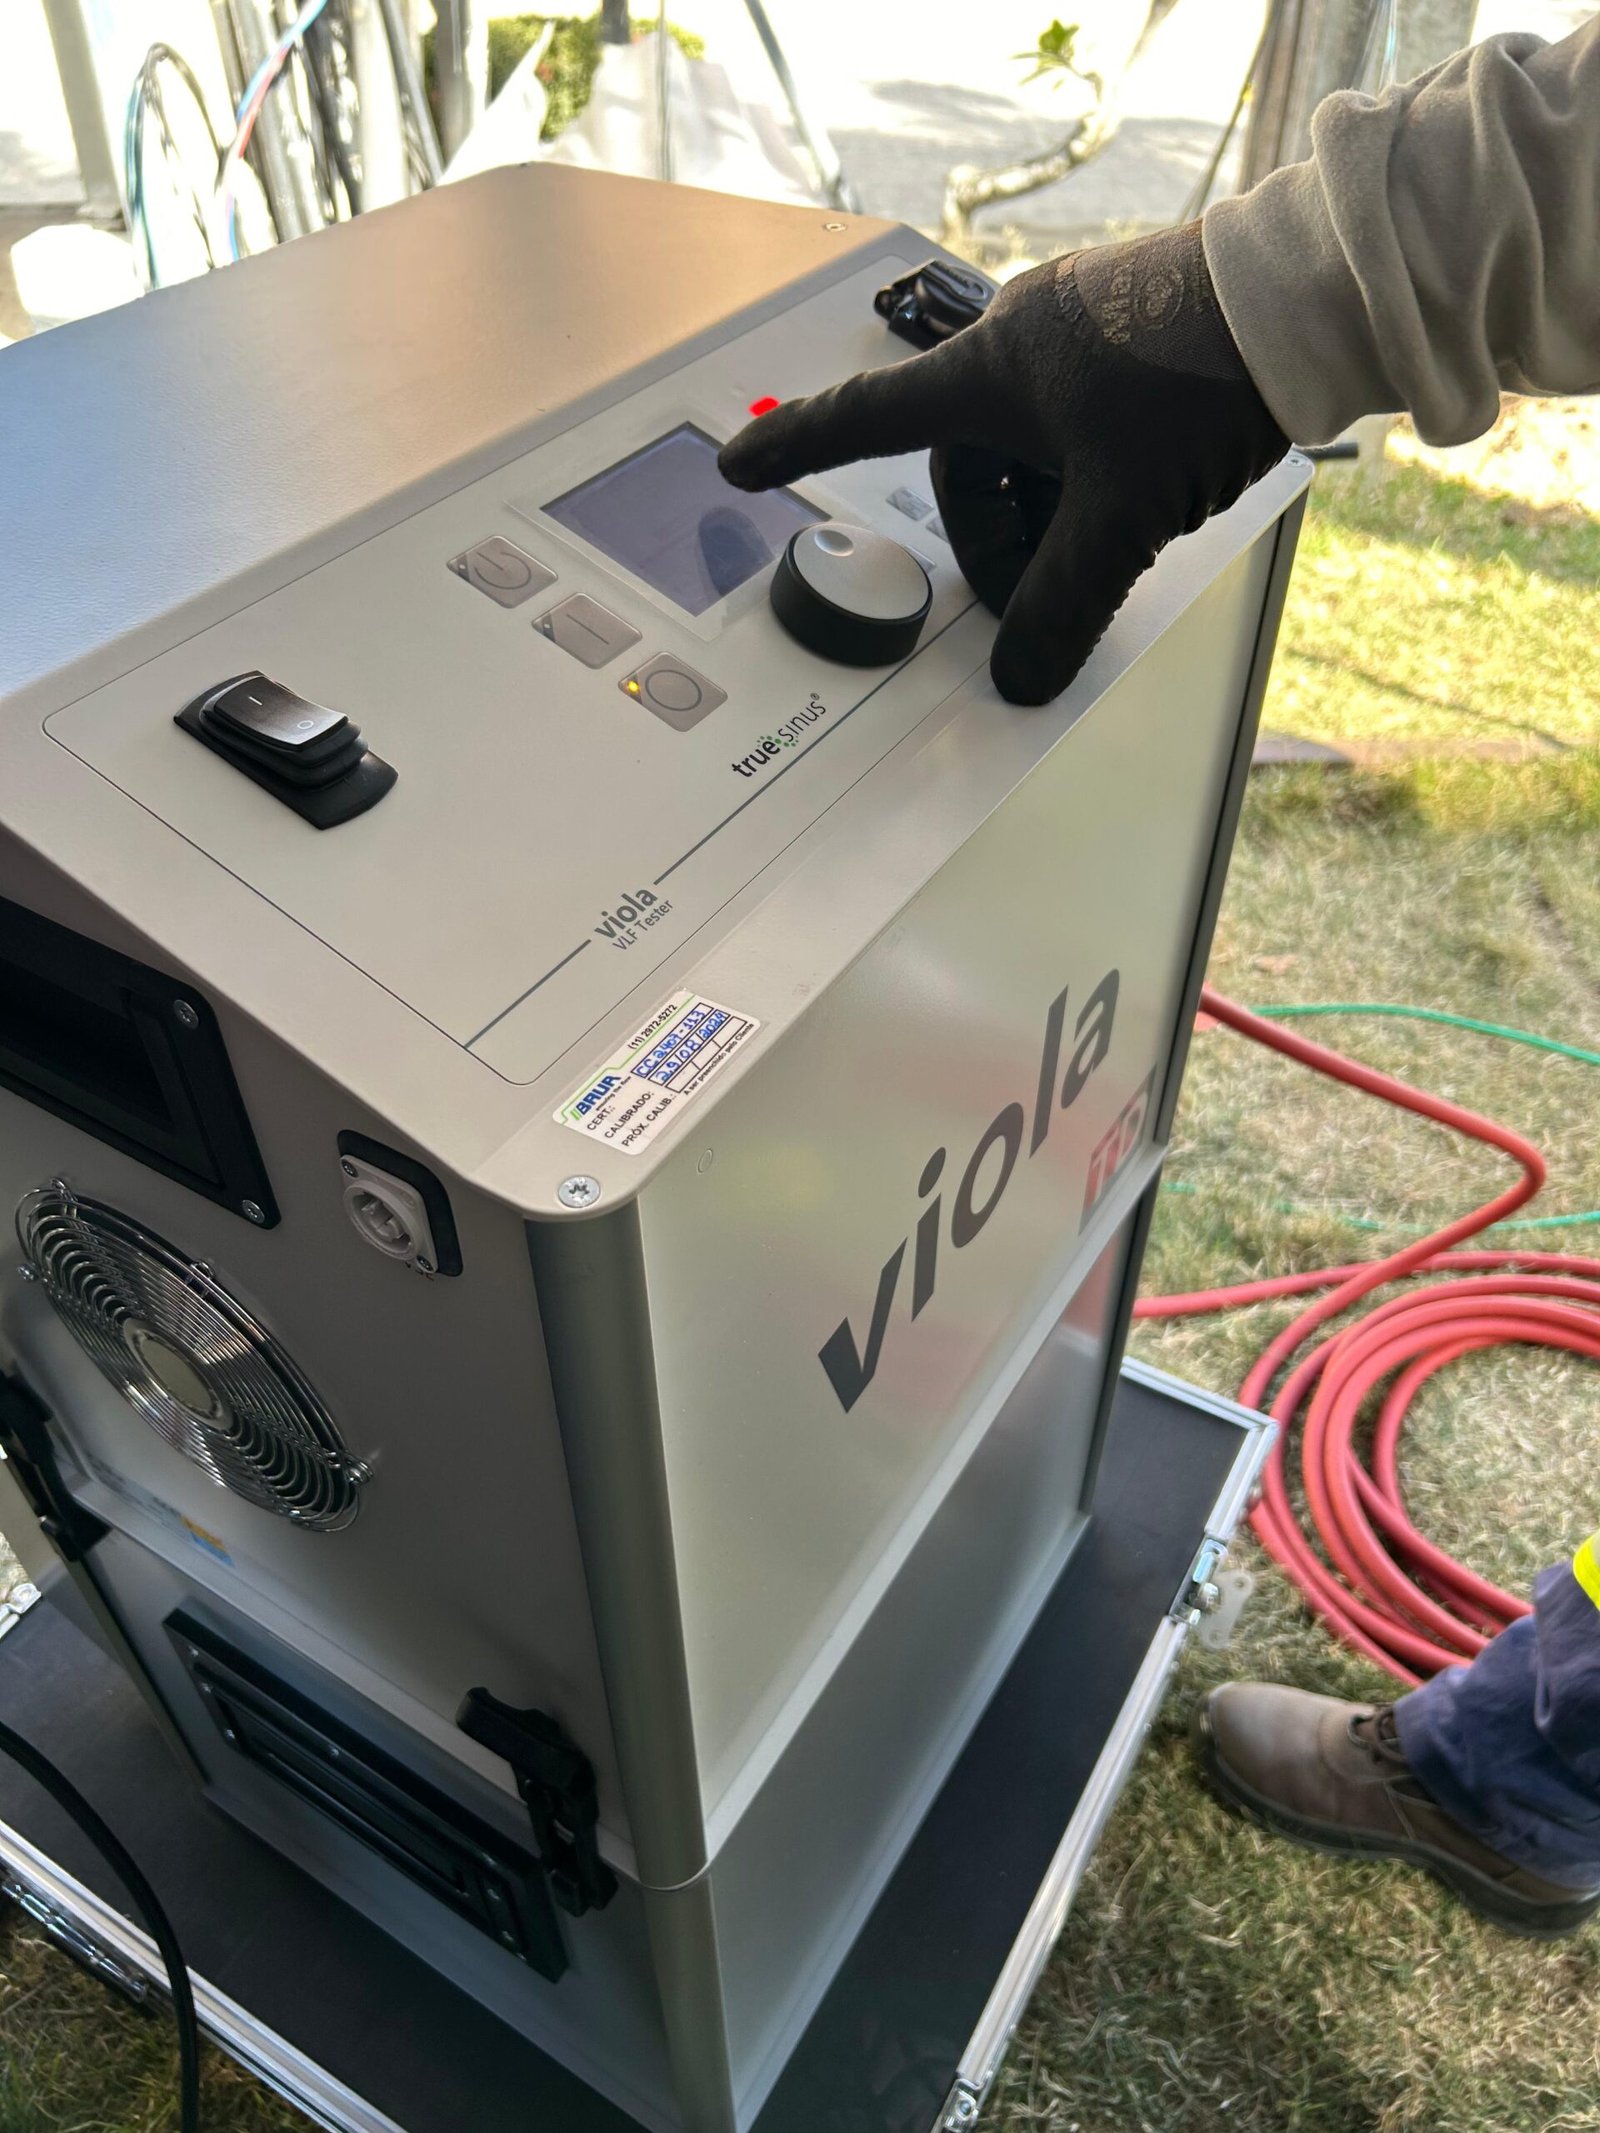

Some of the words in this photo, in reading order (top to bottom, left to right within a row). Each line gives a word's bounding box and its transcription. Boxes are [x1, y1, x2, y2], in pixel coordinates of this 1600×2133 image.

[594, 889, 658, 940] viola
[612, 922, 639, 950] VLF
[634, 899, 674, 932] Tester
[627, 1034, 645, 1050] (11)
[642, 1004, 678, 1038] 2972-5272
[735, 1023, 754, 1041] Cliente
[575, 1075, 622, 1115] BAUR
[604, 1091, 655, 1139] CALIBRADO:
[621, 1122, 650, 1147] PRÓX.
[818, 968, 1120, 1414] viola
